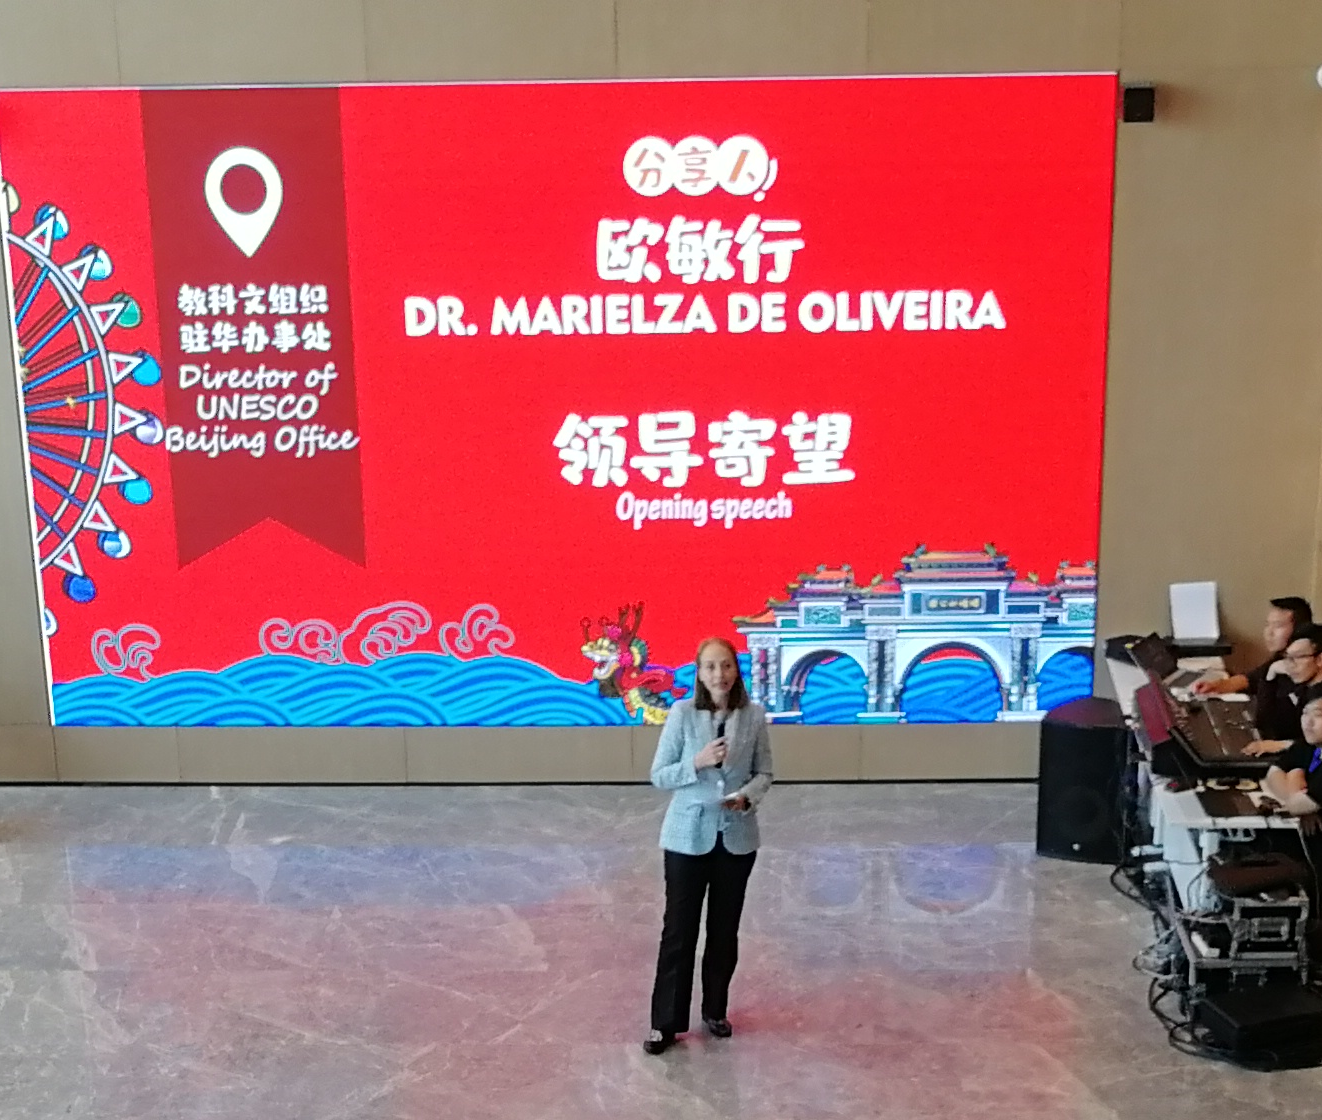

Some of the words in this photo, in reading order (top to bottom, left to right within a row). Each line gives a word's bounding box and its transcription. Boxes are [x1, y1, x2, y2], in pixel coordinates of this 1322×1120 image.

[629, 142, 761, 192] 分享人
[596, 213, 805, 284] 欧敏行
[177, 283, 329, 316] 教科文组织
[404, 296, 478, 337] DR.
[490, 294, 717, 335] MARIELZA
[727, 292, 787, 333] DE
[798, 290, 1006, 333] OLIVEIRA
[179, 321, 331, 353] 驻华办事处
[179, 364, 297, 390] Director
[305, 363, 338, 394] of
[196, 394, 319, 420] UNESCO
[165, 426, 266, 458] Beijing
[274, 426, 361, 459] Office
[553, 411, 855, 487] 领导寄望
[616, 492, 708, 530] Opening
[711, 491, 792, 528] speech
